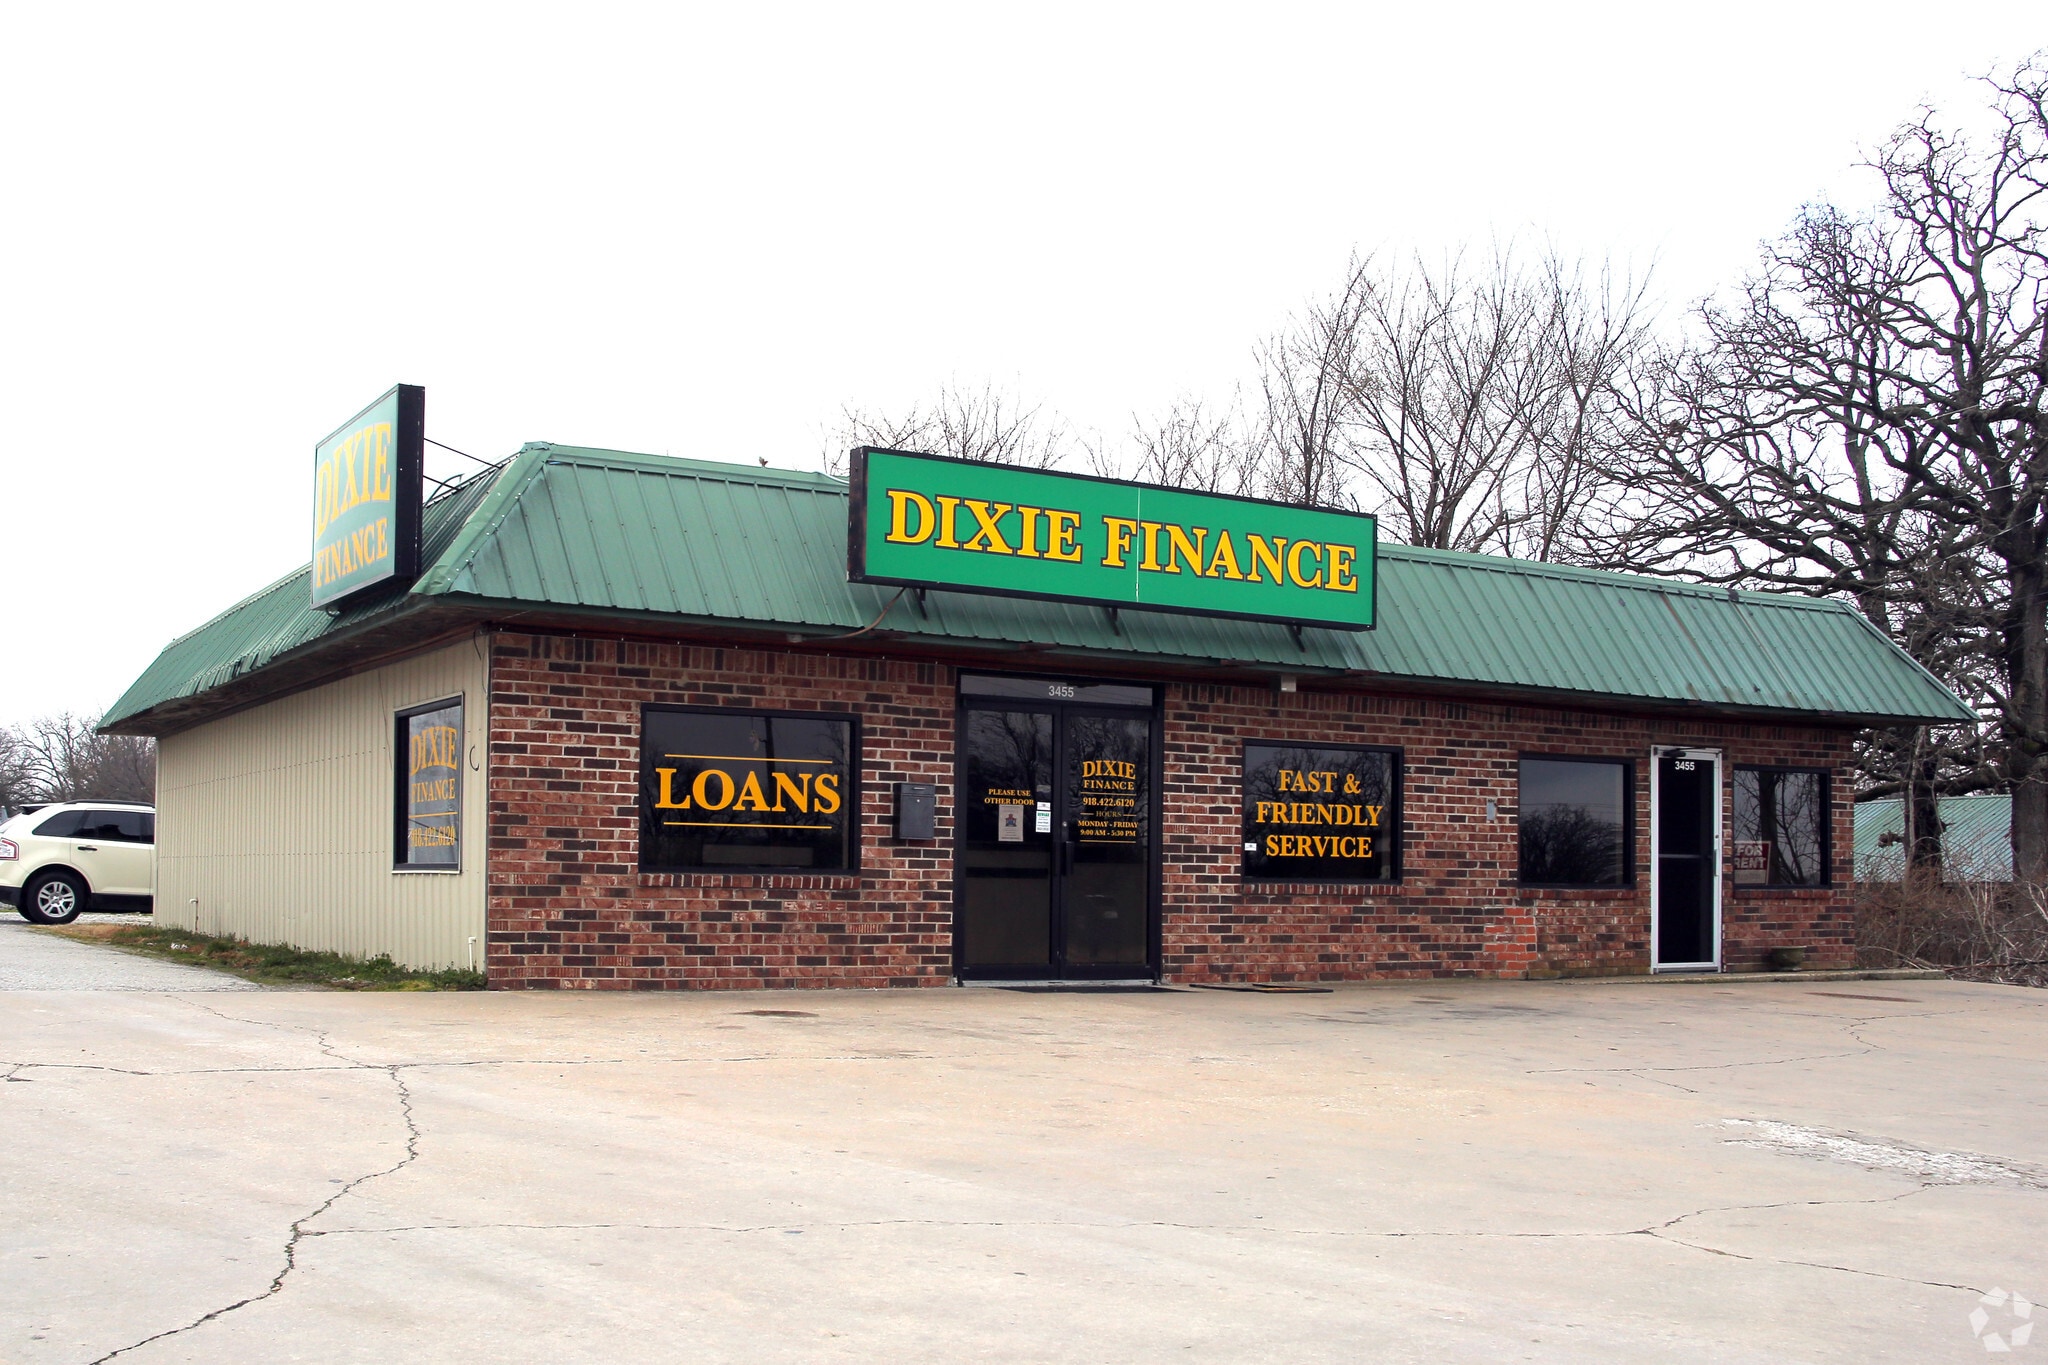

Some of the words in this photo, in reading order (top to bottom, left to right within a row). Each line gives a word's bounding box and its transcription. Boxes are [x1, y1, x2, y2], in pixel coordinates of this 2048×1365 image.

[316, 422, 392, 540] DIXIE
[885, 488, 1083, 564] DIXIE
[1101, 515, 1358, 593] FINANCE
[316, 517, 389, 588] FINANCE
[1048, 685, 1074, 698] 3455
[410, 726, 458, 776] DIXIE
[1082, 760, 1136, 780] DIXIE
[1675, 761, 1695, 771] 3455
[411, 778, 456, 804] FINANCE
[655, 767, 841, 814] LOANS
[1083, 780, 1135, 790] FINANCE
[1278, 770, 1338, 793] FAST
[1343, 773, 1362, 794] &
[984, 797, 1011, 805] OTHER
[1012, 798, 1034, 806] DOOR
[988, 788, 1015, 796] PLEASE
[1016, 789, 1031, 797] USE
[1082, 797, 1135, 807] 918.422.6120
[1095, 810, 1122, 818] HOURS
[1255, 801, 1383, 826] FRIENDLY
[1266, 834, 1373, 858] SERVICE
[1736, 845, 1763, 856] FOR
[1735, 857, 1767, 869] RENT
